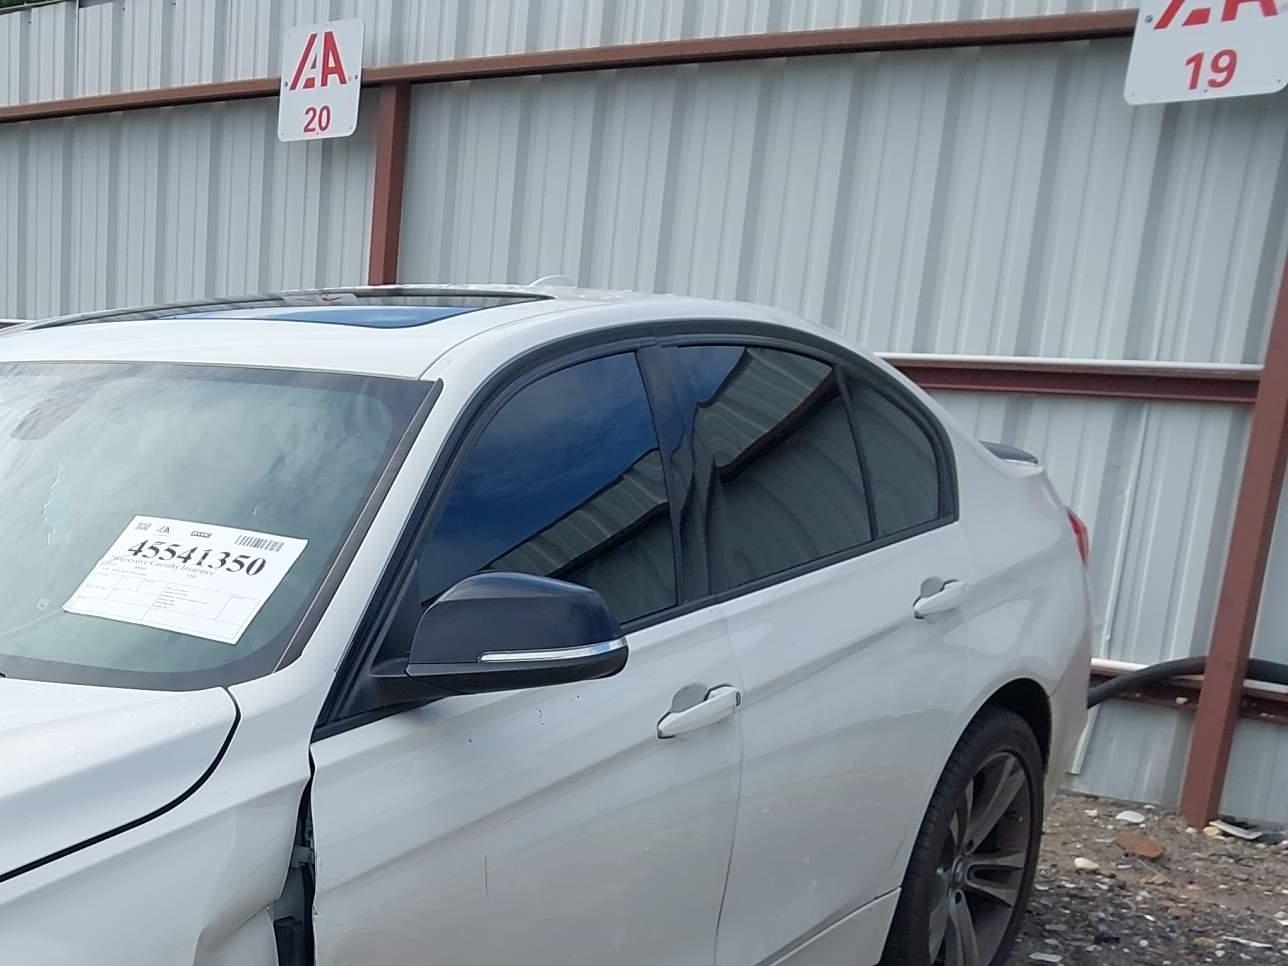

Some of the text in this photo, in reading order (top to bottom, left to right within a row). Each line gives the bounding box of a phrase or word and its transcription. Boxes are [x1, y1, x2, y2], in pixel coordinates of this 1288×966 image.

[1185, 49, 1238, 90] 19
[303, 105, 331, 133] 20
[128, 539, 267, 577] 45541350
